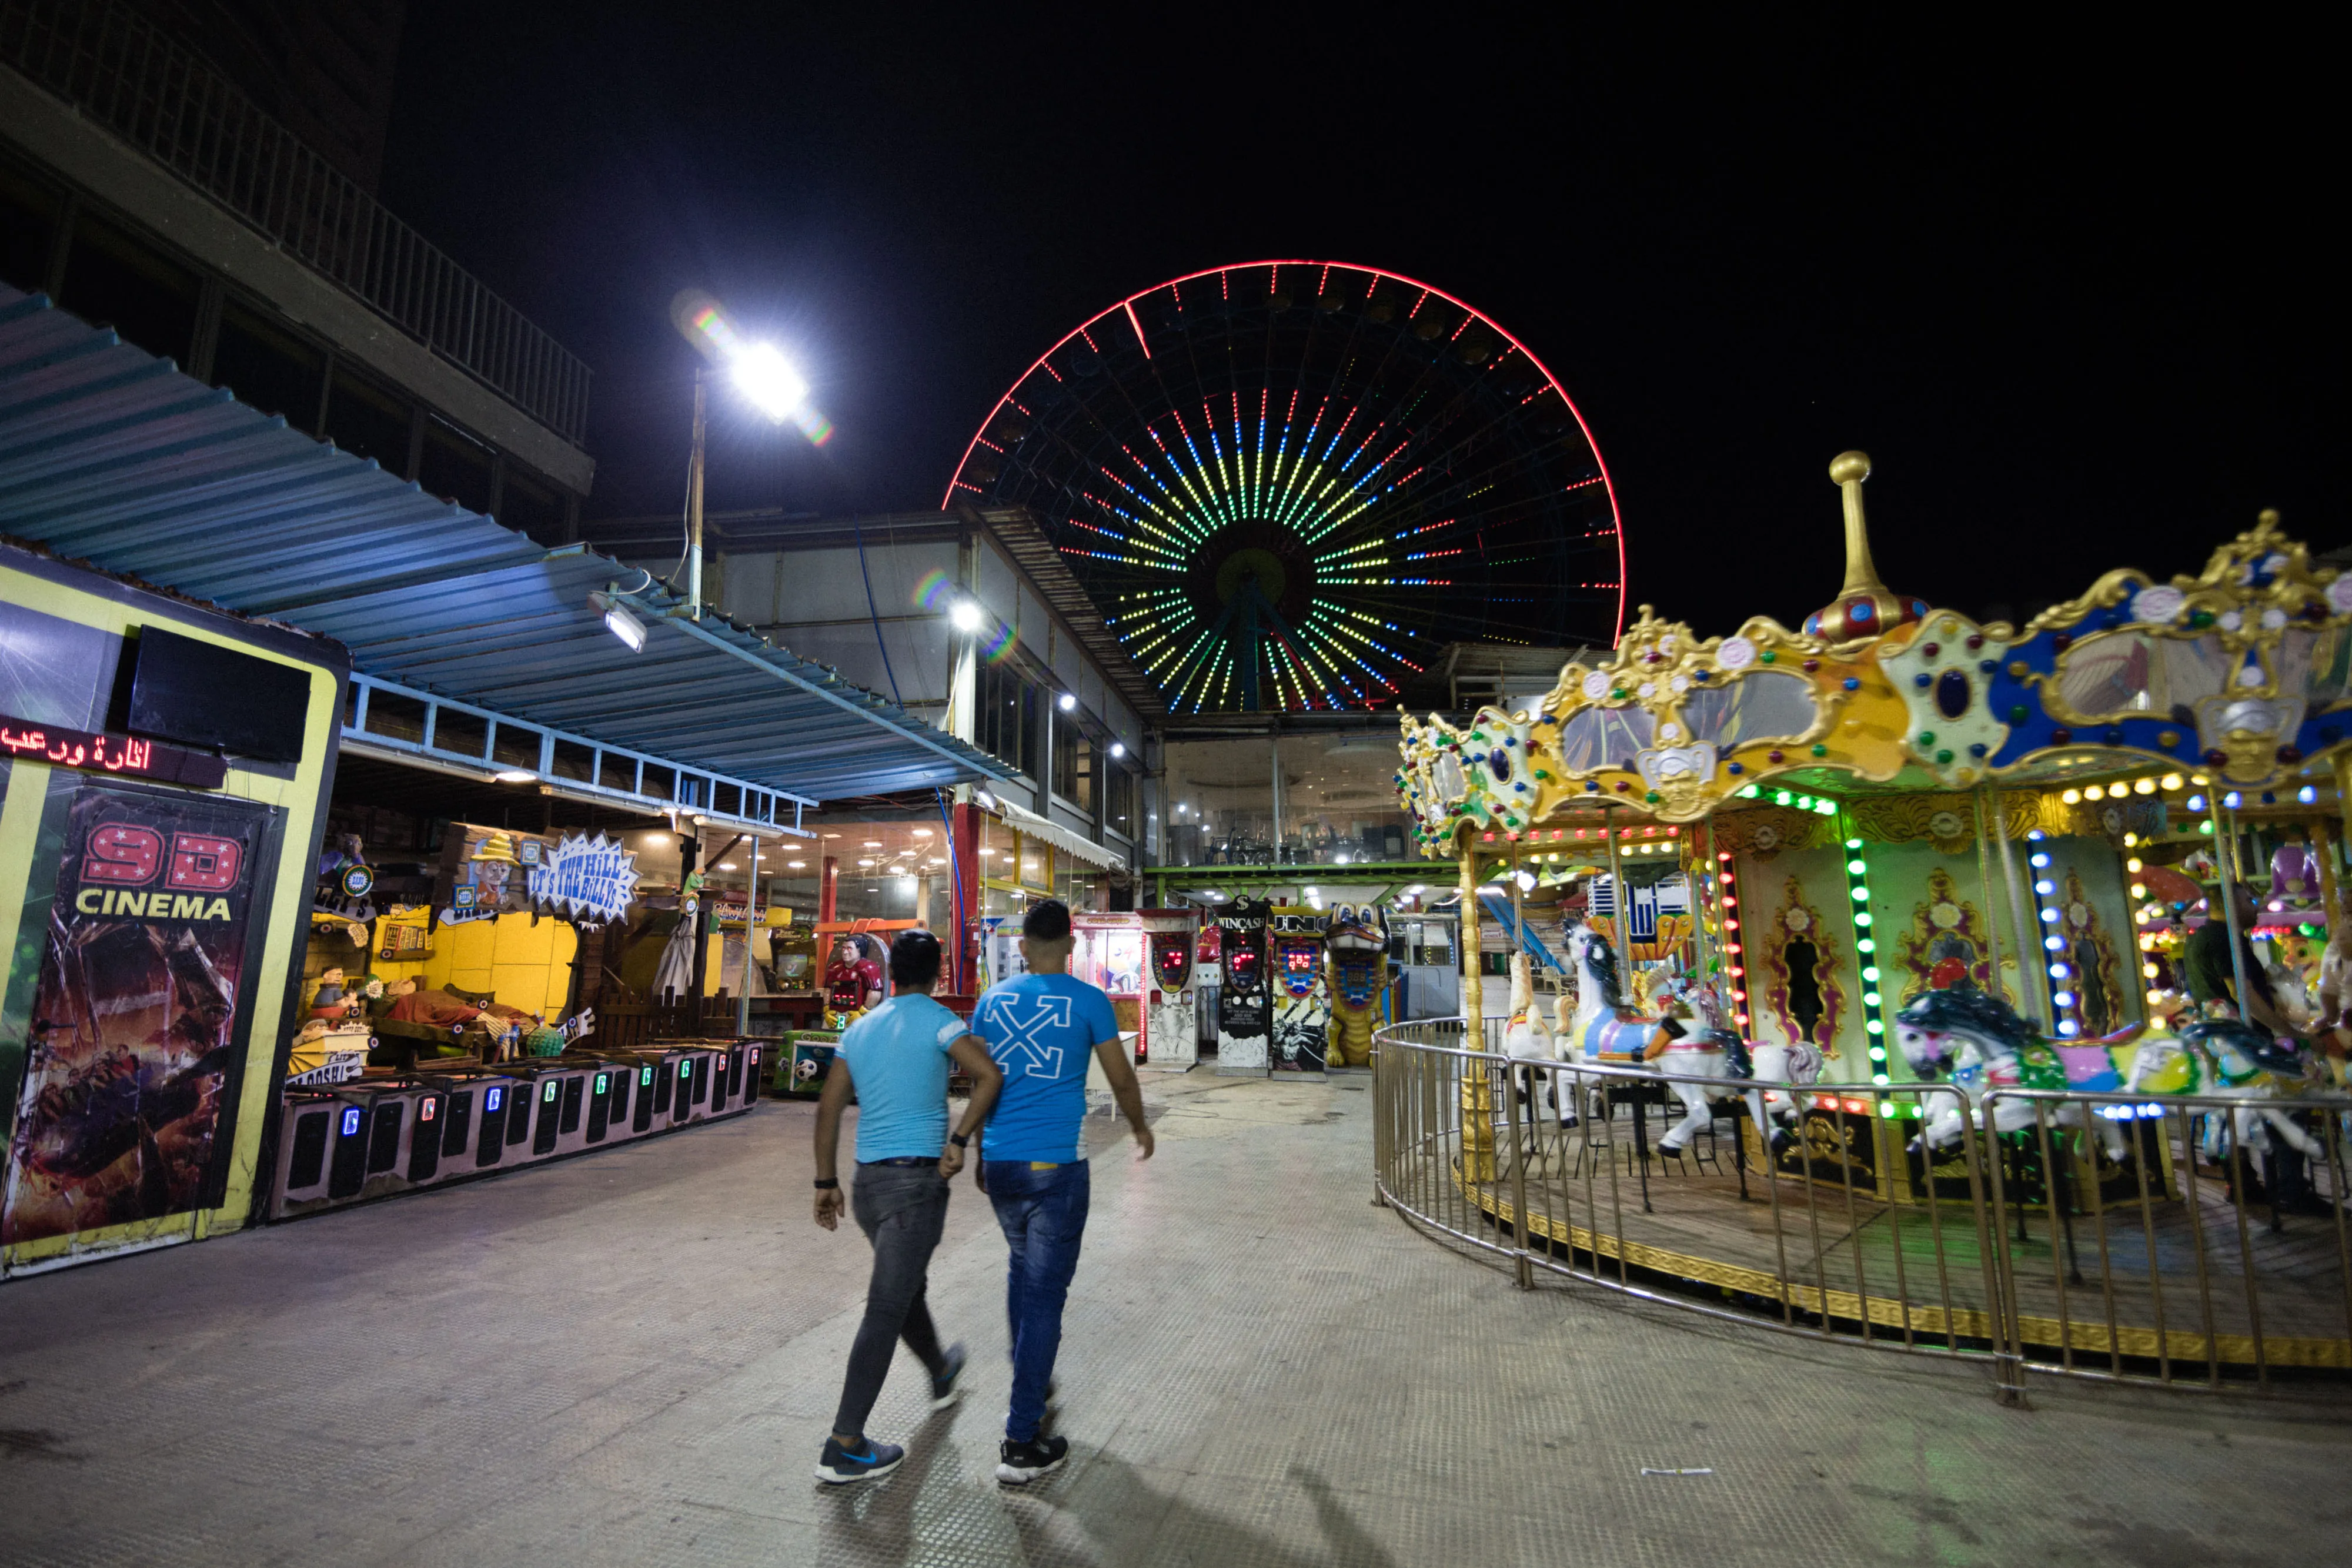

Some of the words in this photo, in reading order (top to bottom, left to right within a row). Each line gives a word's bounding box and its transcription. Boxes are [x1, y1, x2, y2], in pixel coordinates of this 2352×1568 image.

[80, 821, 244, 893] 9D
[557, 855, 584, 899] THE
[75, 888, 232, 921] CINEMA
[1218, 917, 1265, 930] WINCASH
